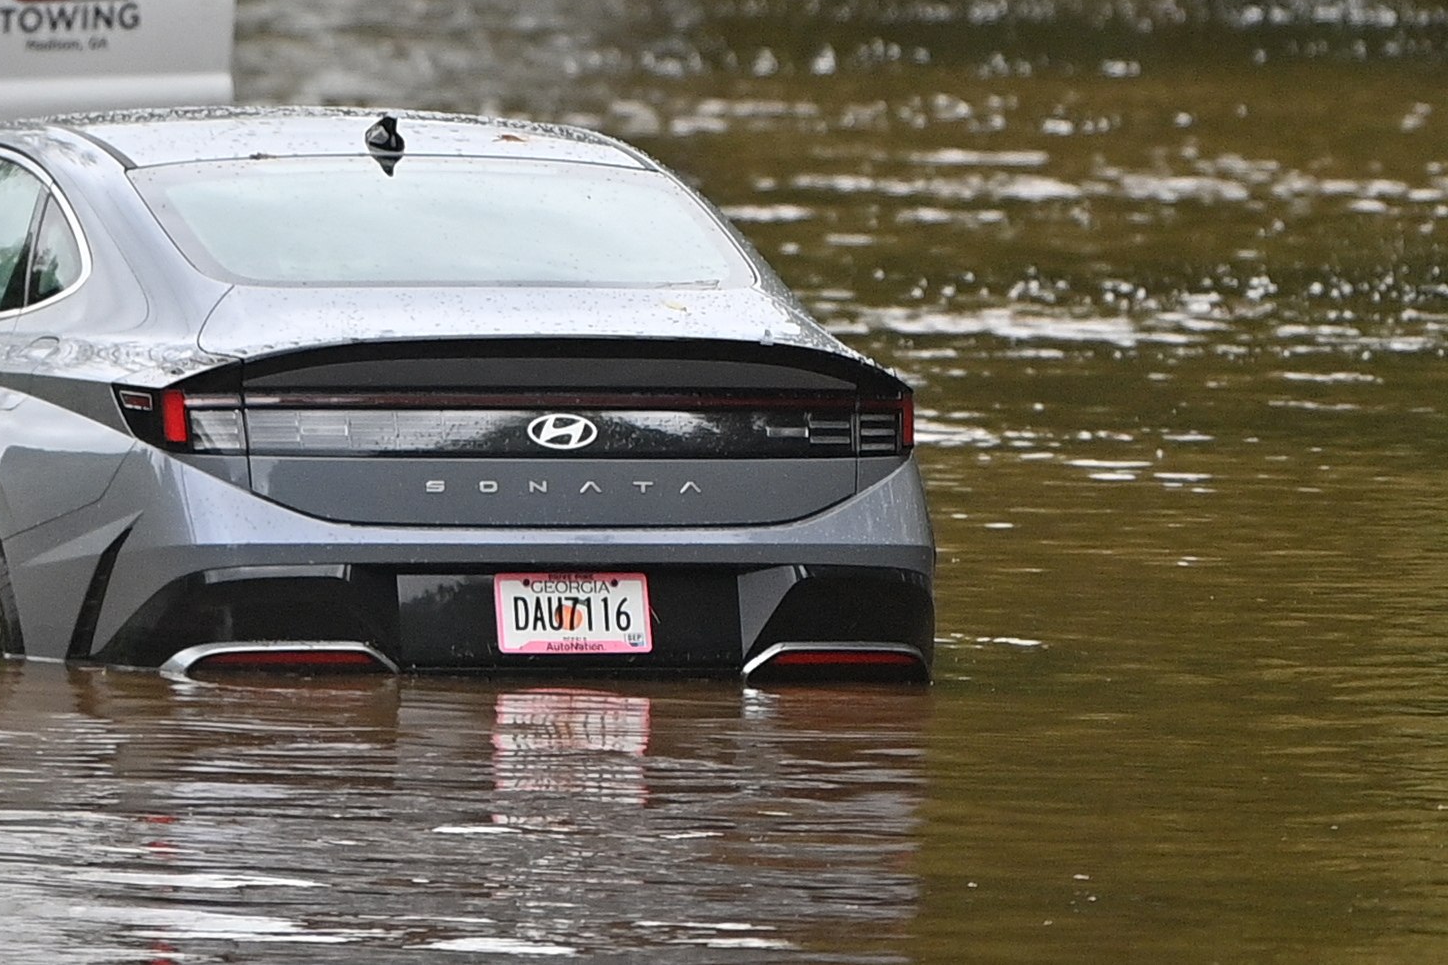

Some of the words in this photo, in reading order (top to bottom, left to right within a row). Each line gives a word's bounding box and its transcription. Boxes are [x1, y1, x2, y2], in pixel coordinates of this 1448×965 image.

[0, 3, 140, 33] TOWING
[425, 480, 702, 494] SONATA
[531, 580, 610, 594] GEORGIA
[513, 596, 631, 632] DAU7116
